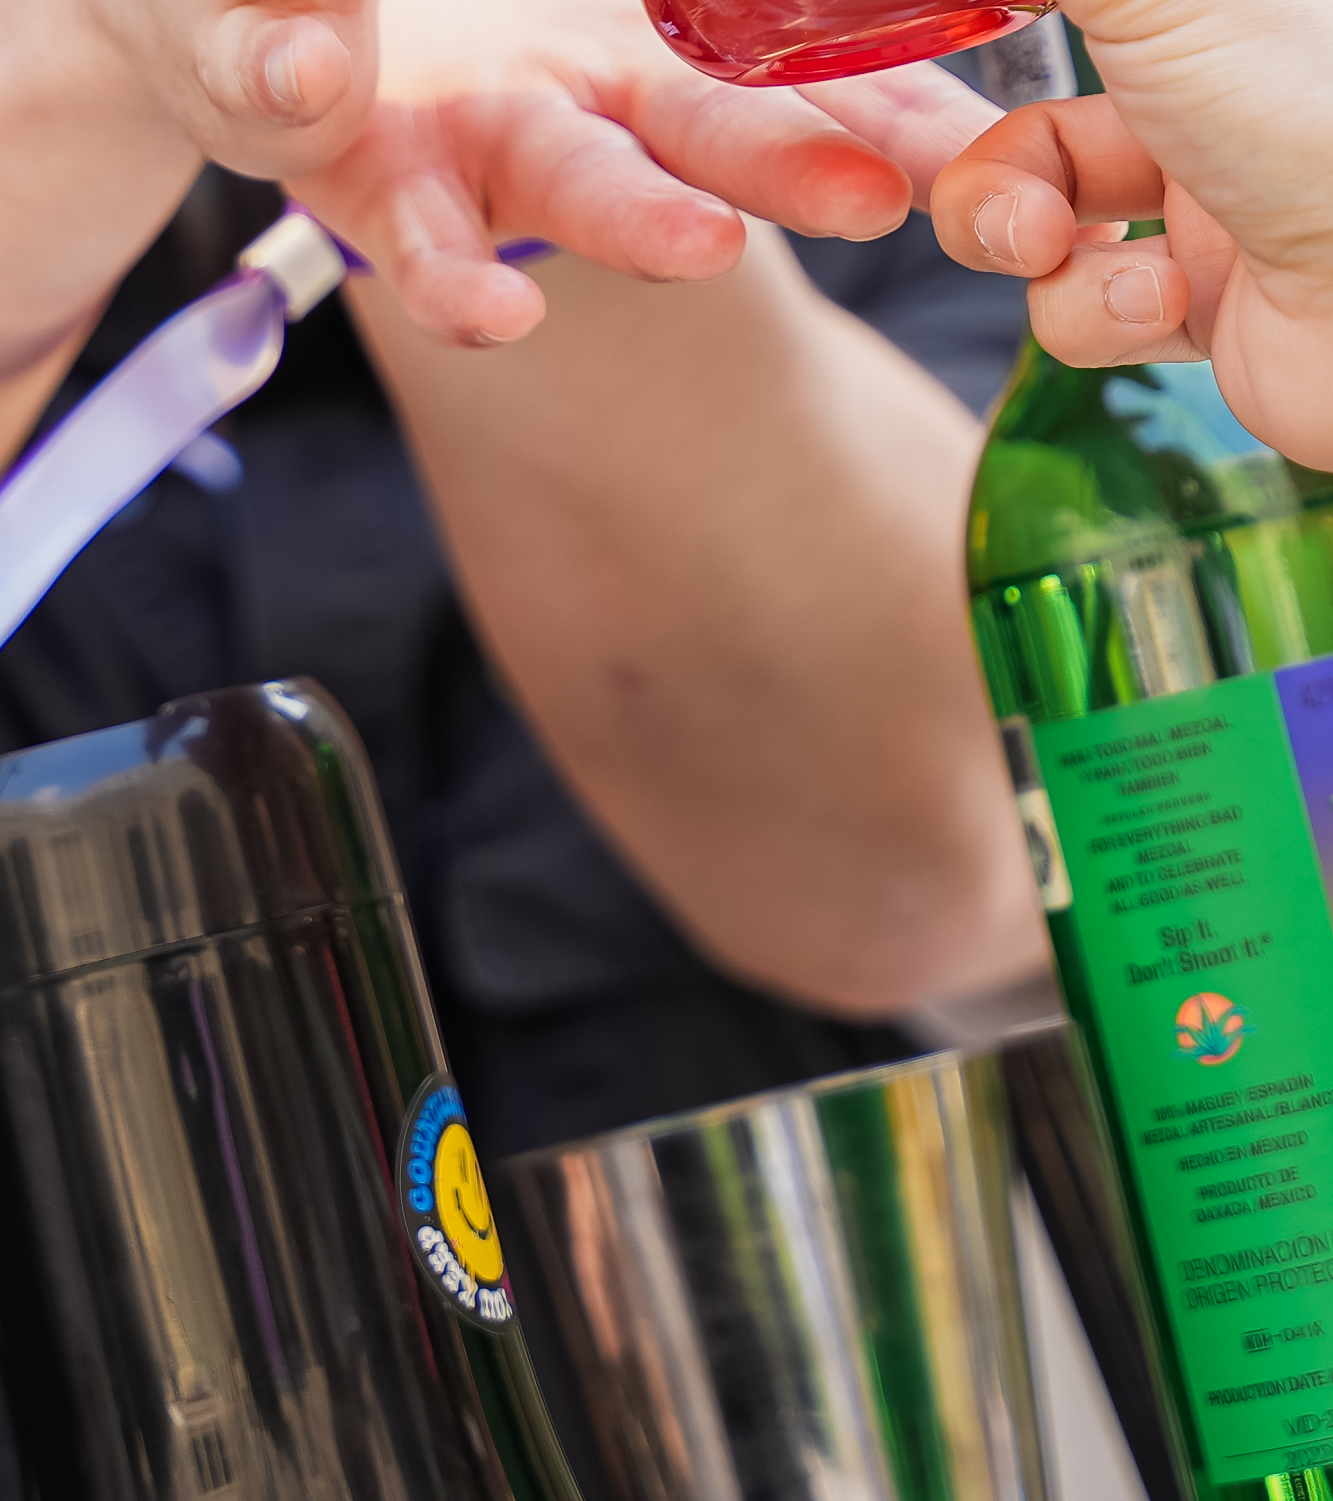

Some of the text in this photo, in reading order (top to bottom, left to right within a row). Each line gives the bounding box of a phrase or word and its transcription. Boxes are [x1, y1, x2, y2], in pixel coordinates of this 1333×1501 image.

[1169, 714, 1230, 741] MEZCAL
[1176, 740, 1213, 761] BIEN
[1158, 848, 1244, 881] CELEBRATE
[1161, 926, 1193, 949] Sip
[1179, 943, 1239, 973] Shoot
[1185, 1090, 1243, 1116] MAGUEY
[1179, 1152, 1225, 1172] HECHO
[1227, 1145, 1249, 1161] EN
[1198, 1165, 1300, 1201] PRODUCTO DE
[418, 1225, 478, 1309] KEEP
[1186, 1277, 1252, 1311] ORIGEN
[1208, 1379, 1287, 1406] PRODUCTION
[1288, 1370, 1325, 1392] DATE
